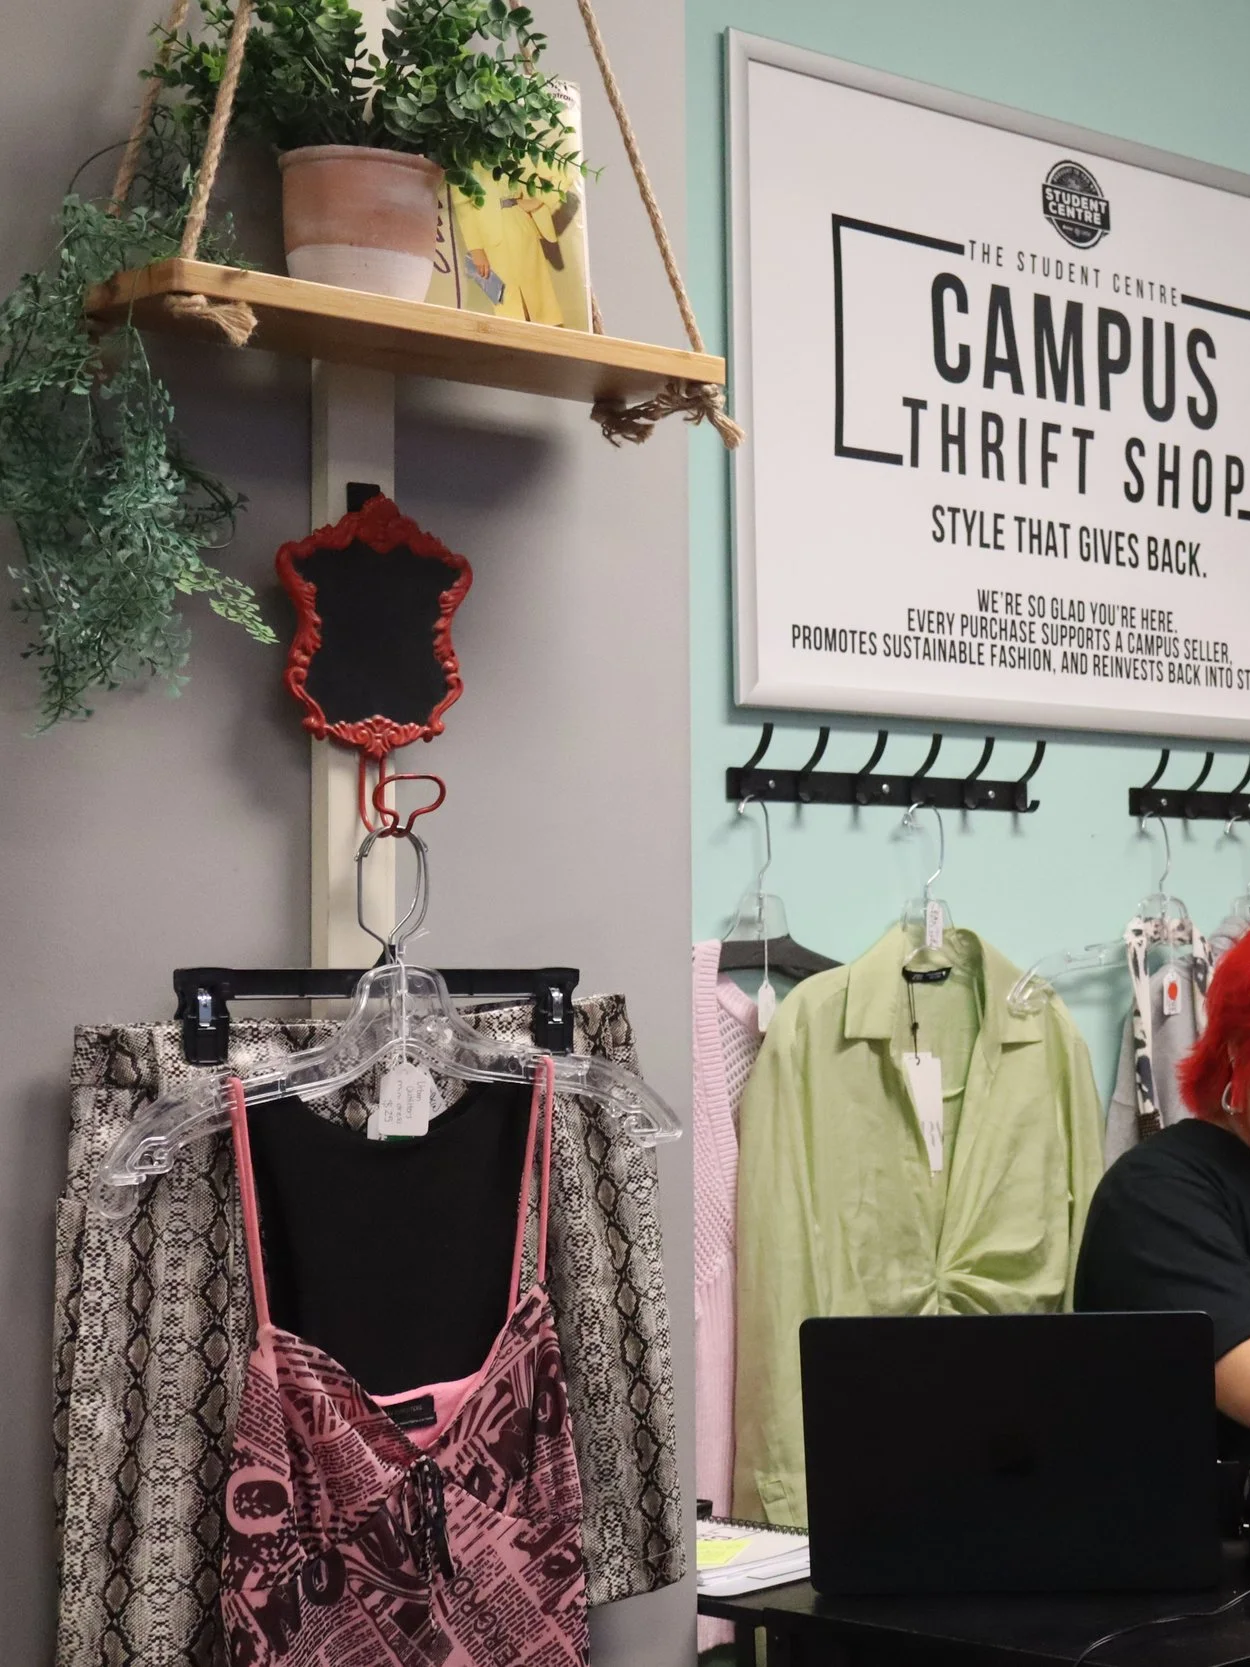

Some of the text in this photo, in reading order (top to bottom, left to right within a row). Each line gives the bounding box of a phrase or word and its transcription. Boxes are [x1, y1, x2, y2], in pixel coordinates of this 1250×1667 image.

[1045, 187, 1107, 214] STUDENT
[1048, 202, 1102, 225] CENTRE
[969, 240, 1177, 306] THE STUDENT CENTRE
[931, 272, 1218, 430] CAMPUS
[902, 396, 1245, 517] THRIFT SHOP
[932, 504, 1207, 578] STYLE THAT GIVES BACK.
[907, 608, 1233, 665] EVERY PURCHASE SUPPORTS A CAMPUS SELLER,
[977, 589, 1178, 633] WE'RE SO GLAD YOU'RE HERE.
[791, 624, 877, 656] PROMOTES
[883, 633, 985, 665] SUSTAINABLE
[990, 644, 1056, 675] FASHION,
[1061, 651, 1088, 675] AND
[1093, 654, 1163, 682] REINVESTS
[1168, 662, 1201, 686] BACK
[1205, 666, 1233, 689] INTO
